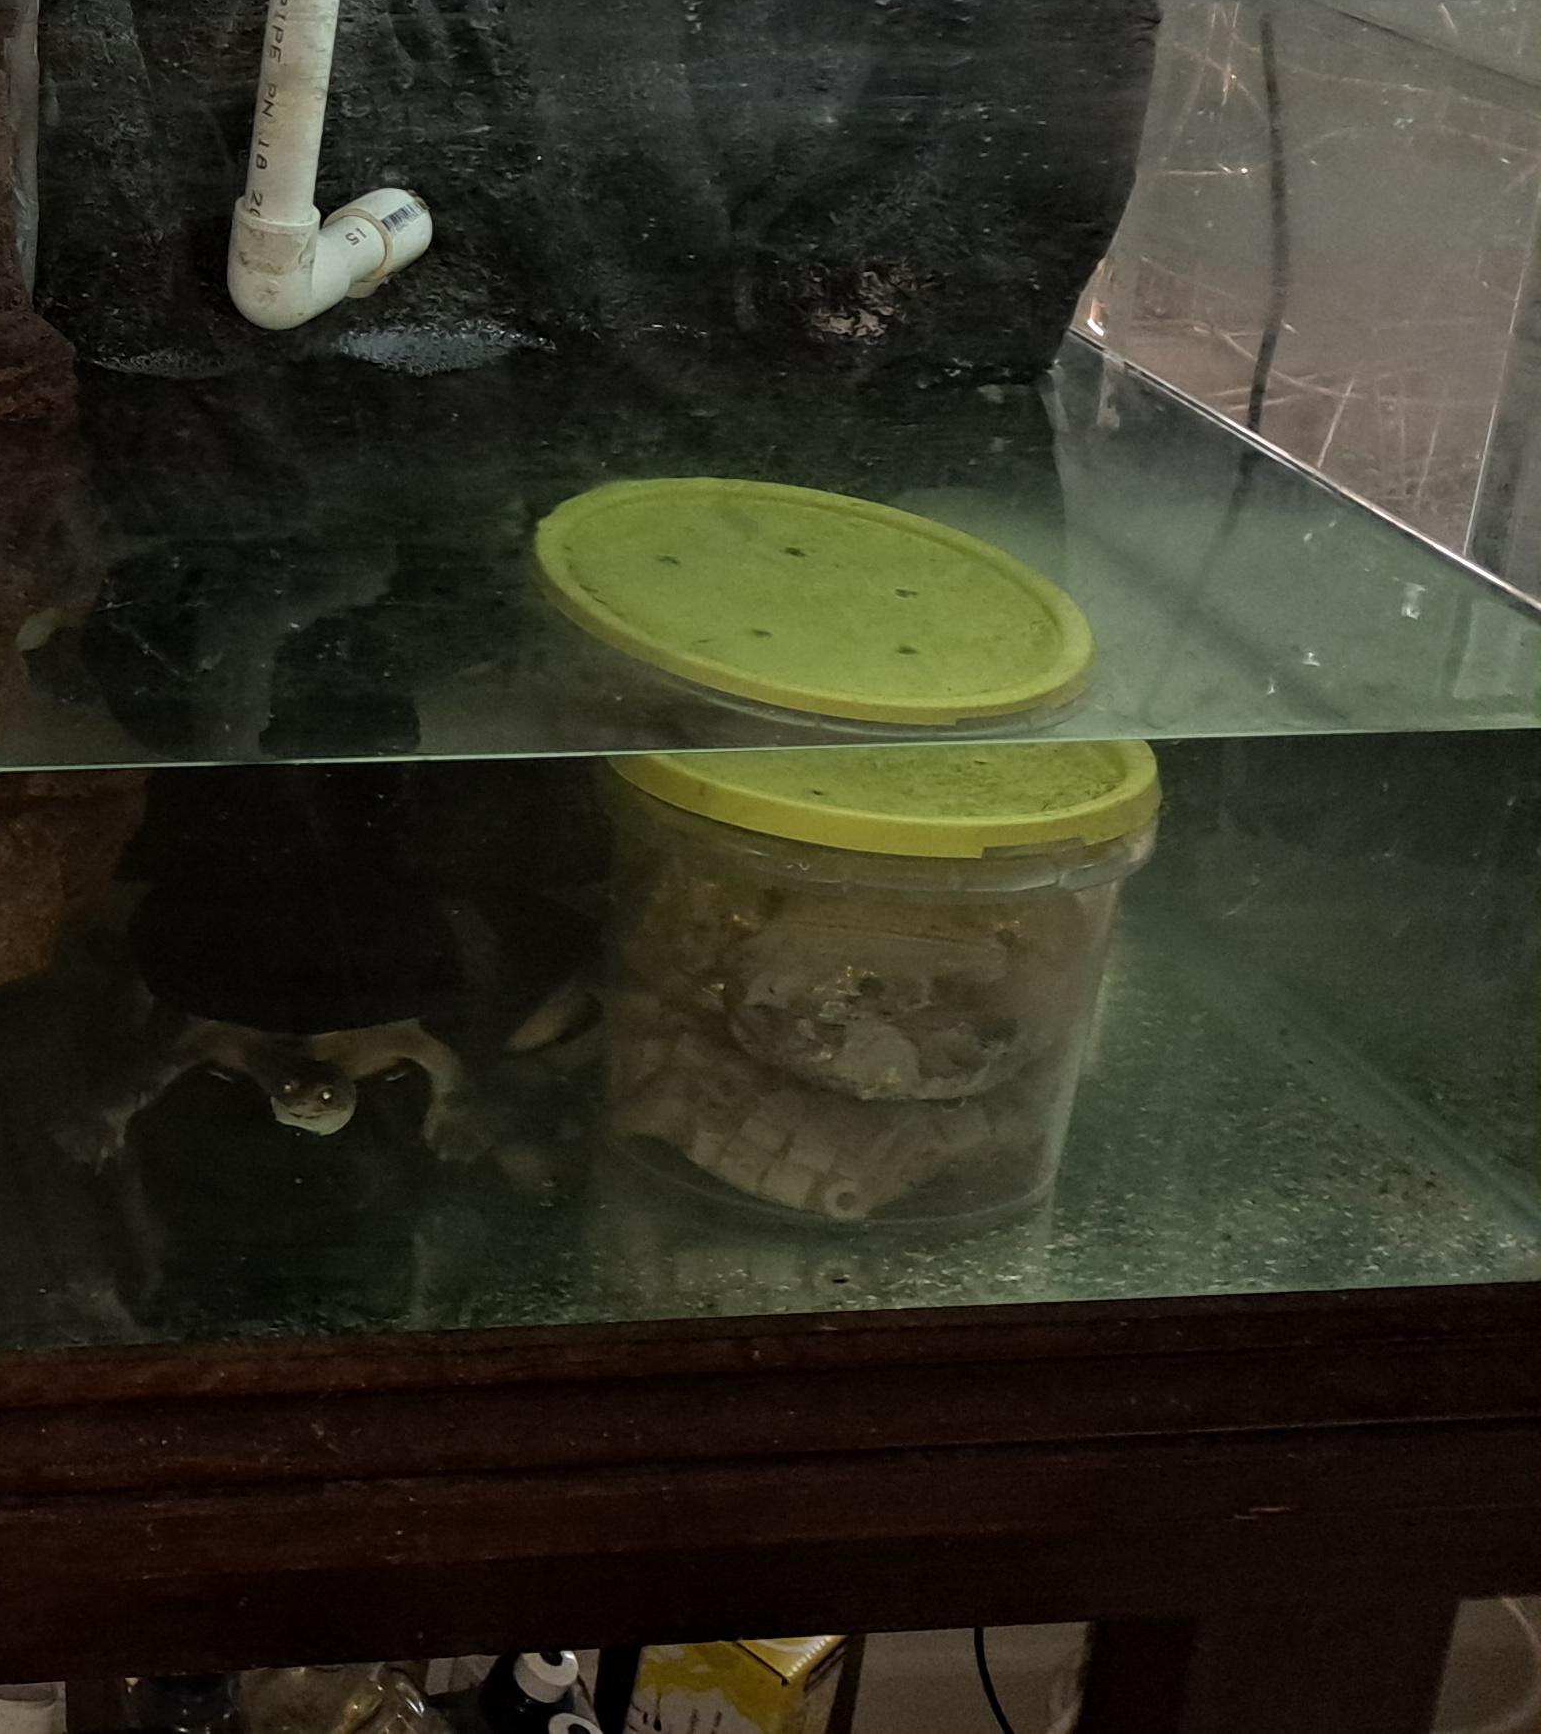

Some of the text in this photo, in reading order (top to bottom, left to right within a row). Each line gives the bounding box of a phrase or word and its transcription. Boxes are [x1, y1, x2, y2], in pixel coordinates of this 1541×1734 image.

[261, 83, 277, 118] PN
[255, 138, 269, 171] 18
[345, 227, 367, 246] 15
